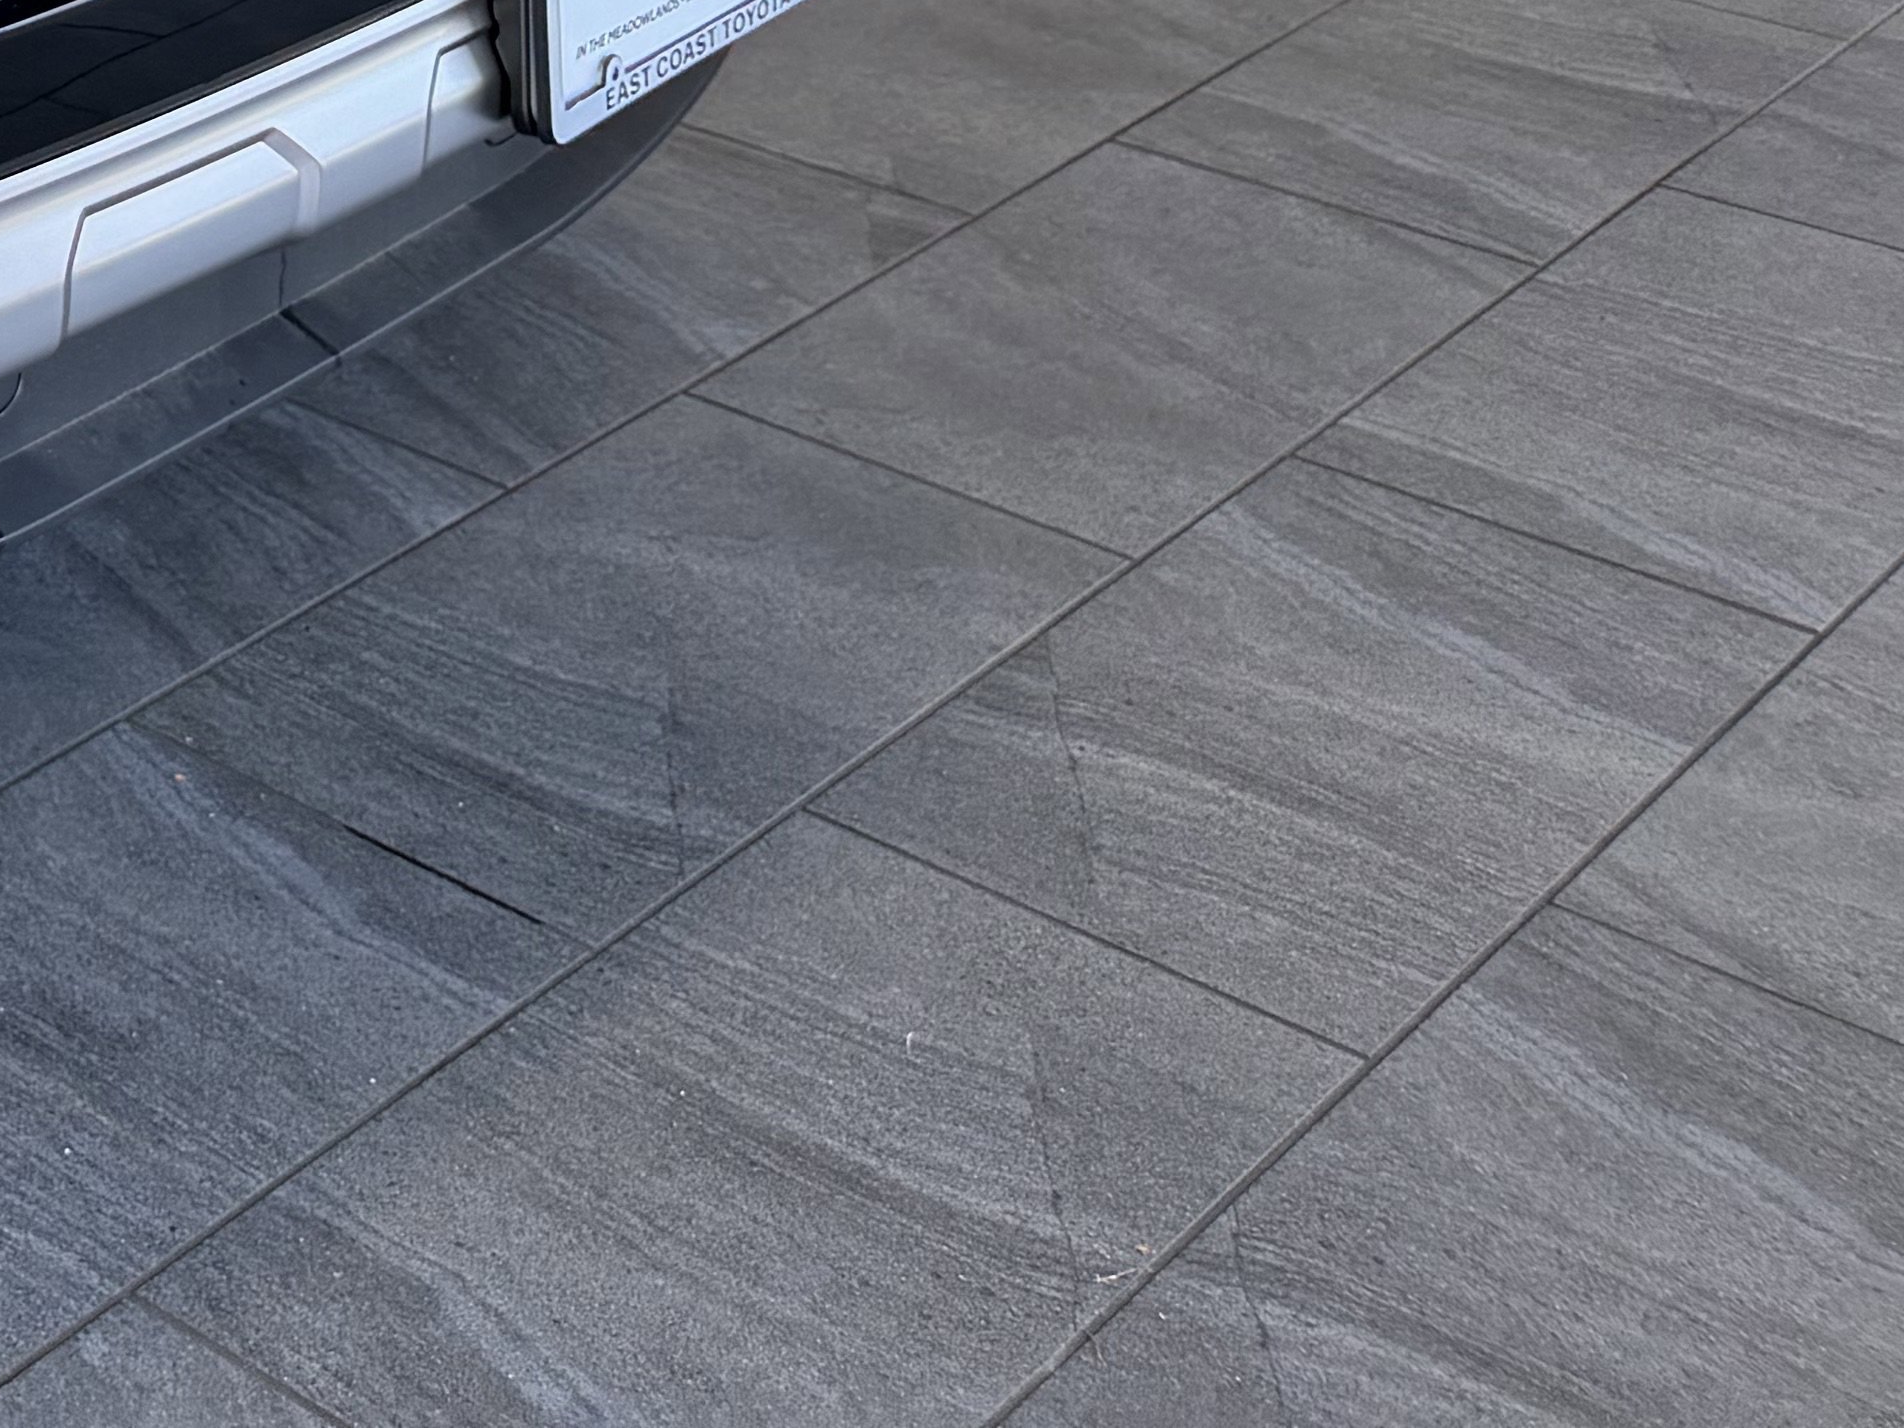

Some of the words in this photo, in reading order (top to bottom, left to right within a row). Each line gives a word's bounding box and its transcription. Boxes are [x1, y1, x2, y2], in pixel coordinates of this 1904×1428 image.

[589, 32, 606, 54] THE
[605, 66, 649, 110] EAST
[656, 25, 717, 78] COAST
